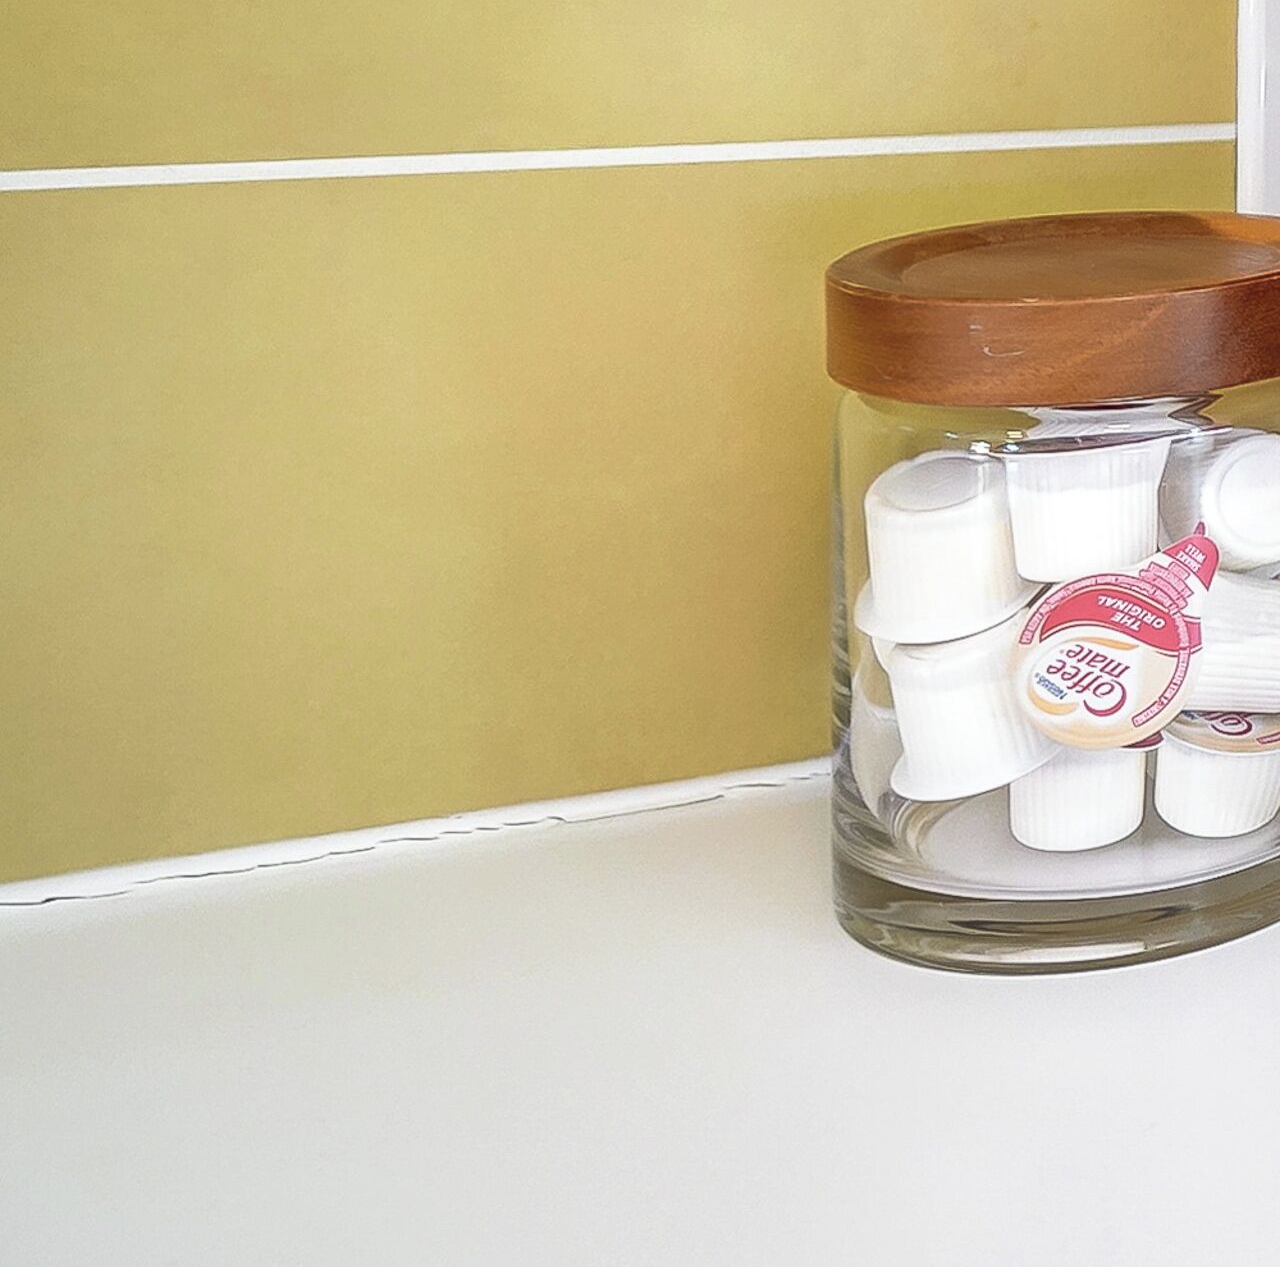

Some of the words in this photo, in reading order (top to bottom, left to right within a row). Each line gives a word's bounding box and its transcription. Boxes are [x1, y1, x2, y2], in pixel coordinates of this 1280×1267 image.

[1097, 595, 1167, 630] ORIGINAL
[1110, 612, 1142, 632] THE
[1065, 643, 1131, 678] mate
[1046, 659, 1127, 718] Coffee
